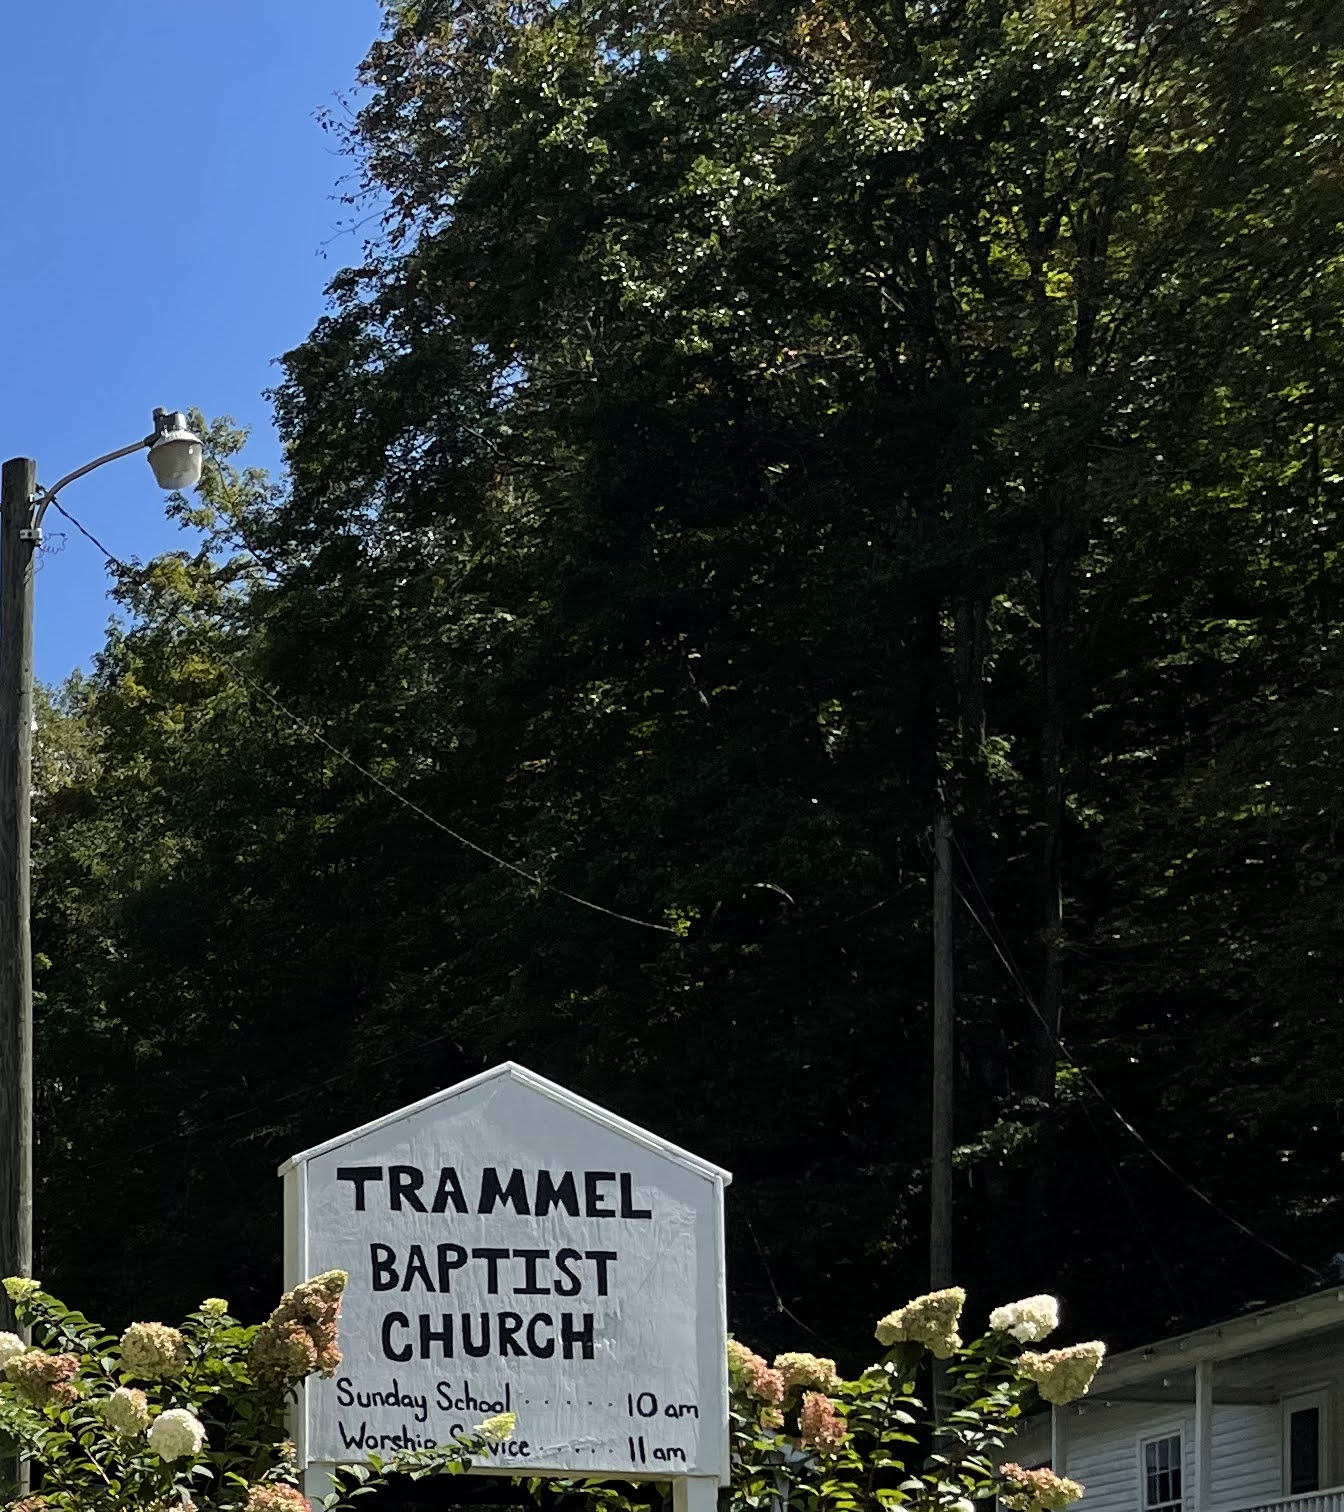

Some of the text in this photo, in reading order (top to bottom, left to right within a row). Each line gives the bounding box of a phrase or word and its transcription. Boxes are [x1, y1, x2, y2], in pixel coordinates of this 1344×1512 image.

[336, 1165, 653, 1220] TRAMMEL
[369, 1242, 618, 1297] BAPTIST
[381, 1311, 595, 1363] CHURCH
[336, 1377, 699, 1423] Sunday School 10 am
[628, 1435, 646, 1465] 11
[652, 1446, 687, 1462] am
